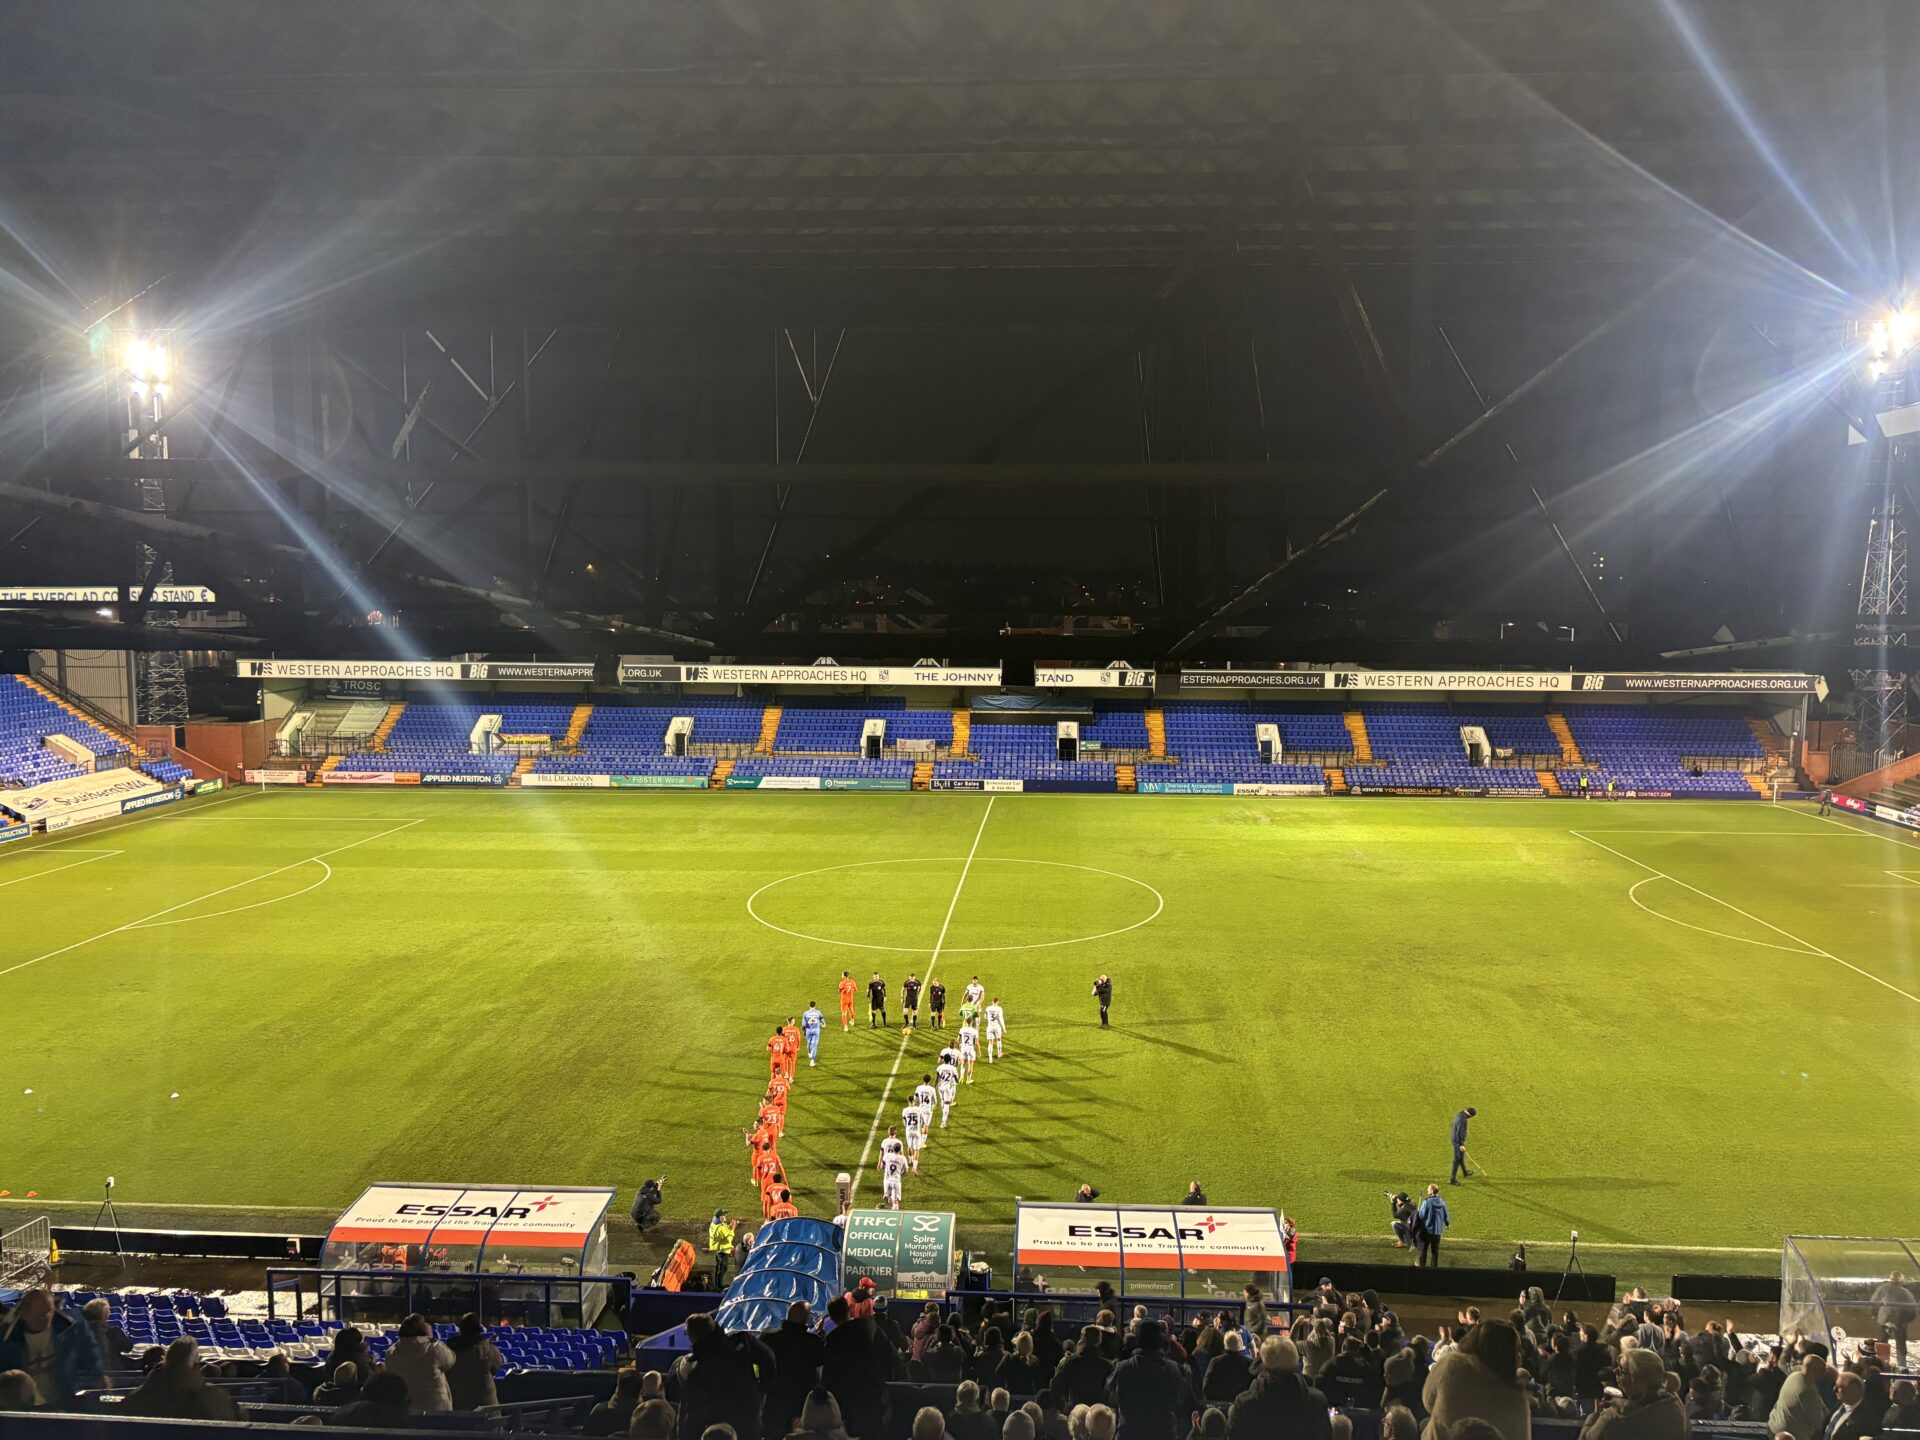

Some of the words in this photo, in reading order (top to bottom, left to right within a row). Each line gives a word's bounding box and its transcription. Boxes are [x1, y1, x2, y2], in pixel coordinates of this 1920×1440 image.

[1, 592, 26, 600] THE
[32, 591, 98, 601] EVERCLAD
[162, 590, 195, 601] STAND
[277, 664, 340, 676] WESTERN
[344, 665, 431, 677] APPROACHES
[436, 666, 454, 677] HQ
[712, 669, 768, 680] WESTERN
[771, 669, 848, 681] APPROACHES
[851, 670, 867, 682] HQ
[914, 672, 939, 682] THE
[942, 672, 994, 682] JOHNNY
[1035, 673, 1074, 683] STAND
[1364, 675, 1433, 687] WESTERN
[1438, 676, 1535, 688] APPROACHES
[1539, 677, 1559, 688] HQ
[343, 680, 381, 691] TROSC
[1625, 678, 1808, 689] WWW.WESTERNAPPROACHES.ORG.UK
[423, 774, 451, 782] APPLIED
[452, 775, 491, 783] NUTRITION
[990, 1013, 996, 1022] 3
[964, 1035, 970, 1045] 2
[939, 1072, 951, 1082] 42
[920, 1094, 930, 1105] 14
[766, 1113, 777, 1124] 23
[907, 1115, 919, 1126] 25
[889, 1163, 897, 1175] 9
[395, 1204, 531, 1219] ESSAR
[522, 1221, 576, 1229] community
[852, 1216, 898, 1227] TRFC
[849, 1231, 895, 1241] OFFICIAL
[1068, 1225, 1205, 1241] ESSAR
[913, 1234, 936, 1244] Spire
[904, 1243, 944, 1251] Murrayfield
[1209, 1244, 1266, 1252] community
[847, 1247, 894, 1258] MEDICAL
[909, 1250, 938, 1259] Hospital
[912, 1257, 934, 1265] Wirral
[845, 1265, 893, 1276] PARTNER
[911, 1274, 935, 1282] Search
[919, 1282, 945, 1290] WIRRAL
